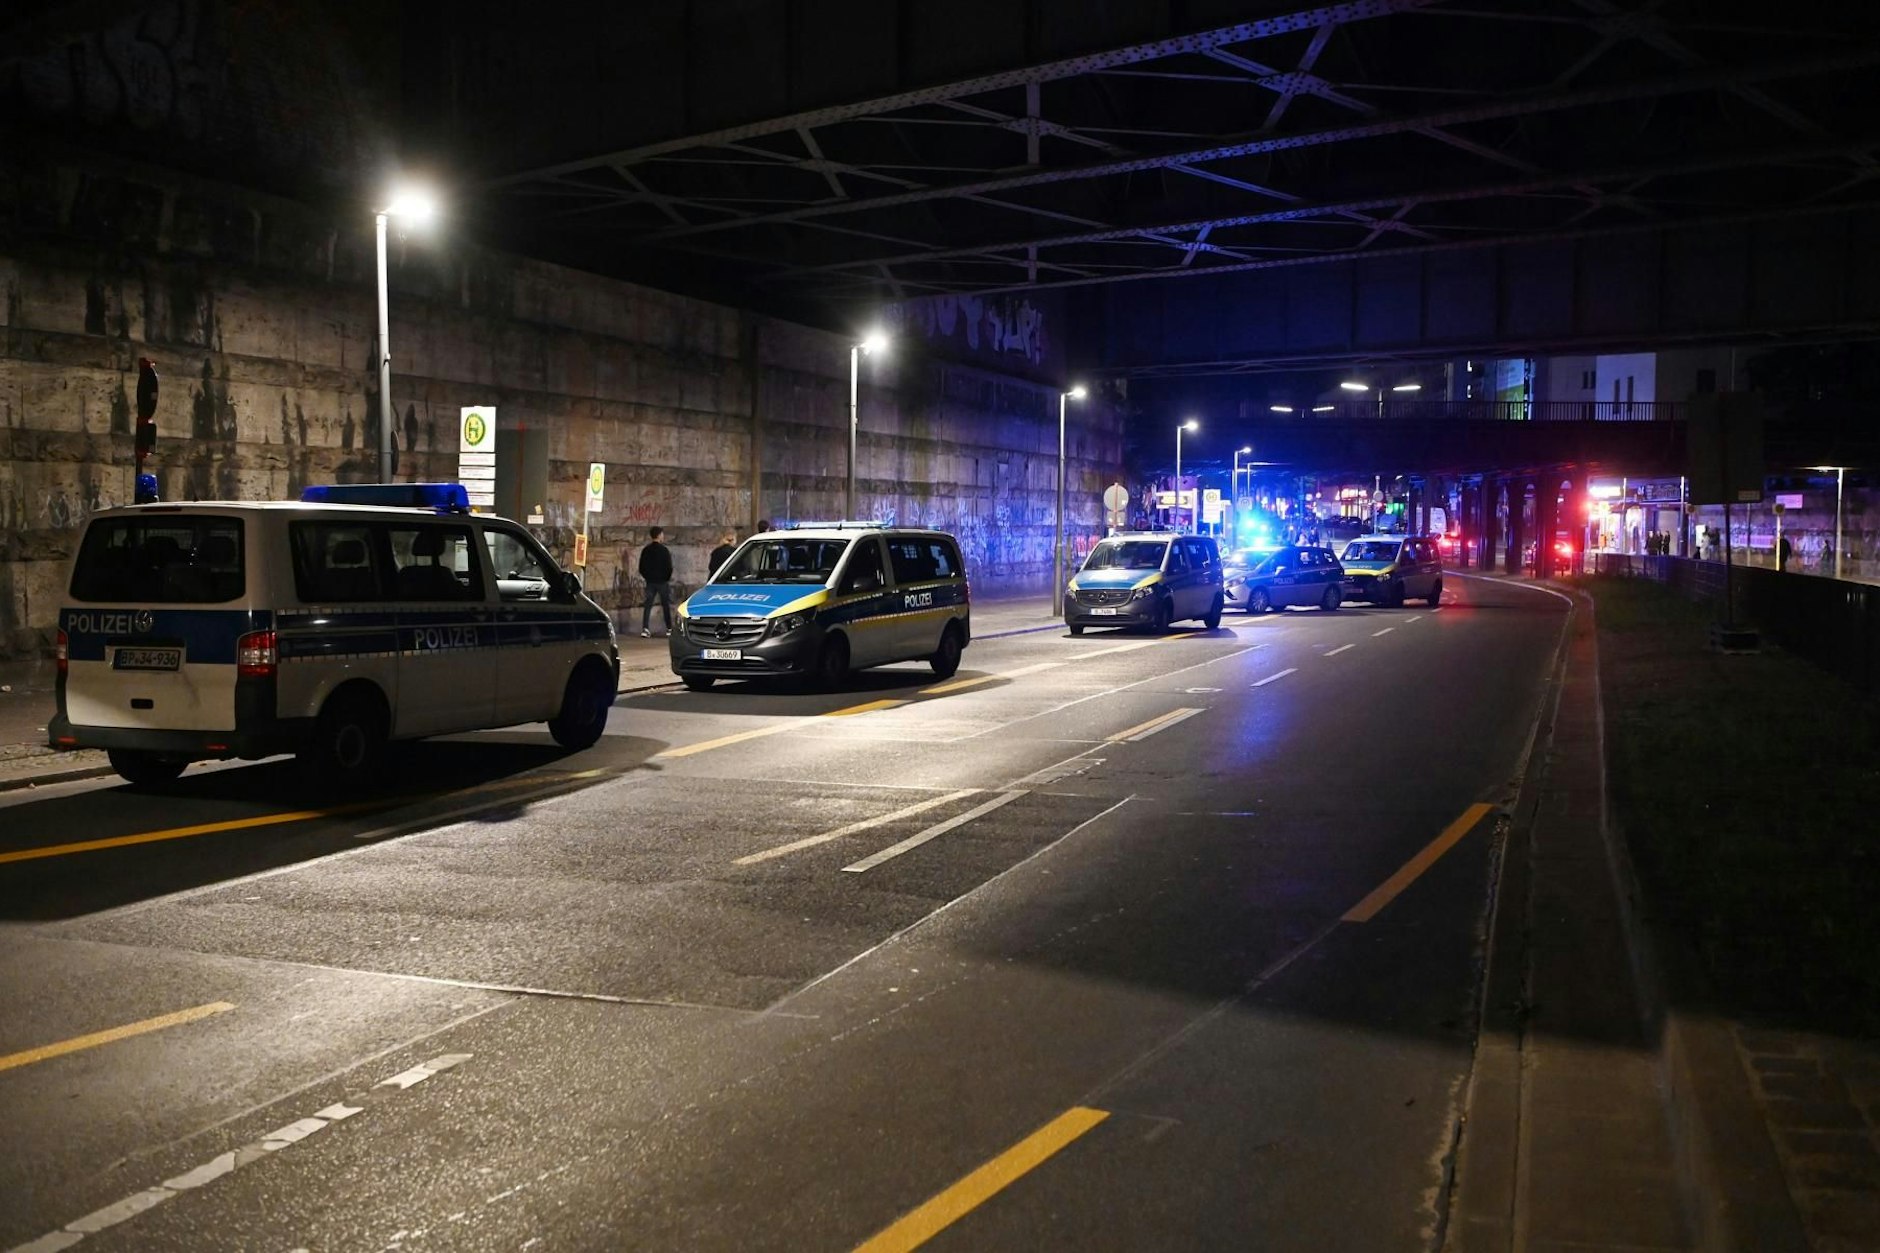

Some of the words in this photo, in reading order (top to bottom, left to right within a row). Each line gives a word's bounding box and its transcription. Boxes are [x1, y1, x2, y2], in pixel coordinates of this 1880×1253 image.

[708, 593, 771, 601] POLIZEI
[904, 593, 933, 609] POLIZEI
[68, 614, 132, 633] POLIZEI
[414, 626, 479, 650] POLIZEI
